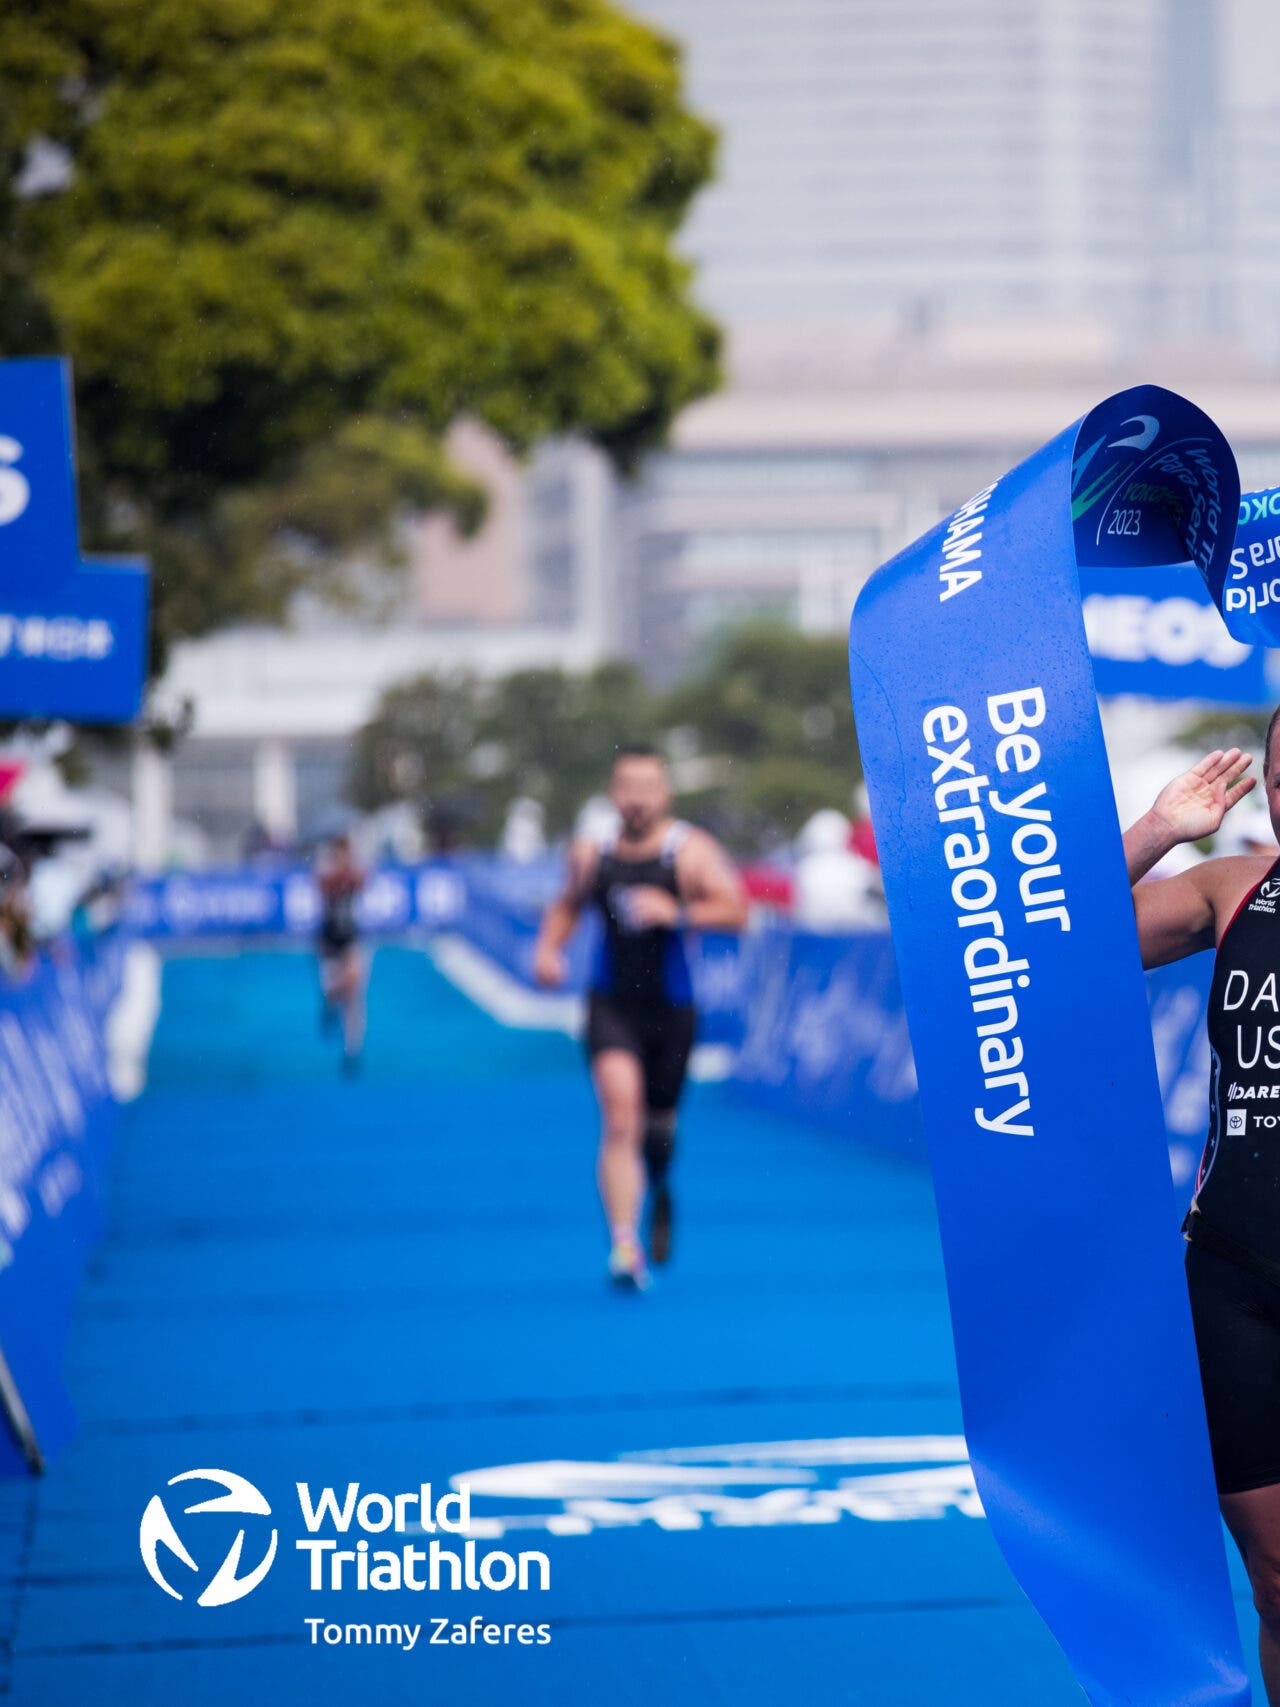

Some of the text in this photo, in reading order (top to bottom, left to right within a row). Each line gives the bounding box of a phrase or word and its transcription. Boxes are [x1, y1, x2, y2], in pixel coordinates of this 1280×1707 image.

[1149, 452, 1199, 488] Para
[1185, 448, 1222, 535] World
[938, 473, 1004, 603] OHAMA
[1106, 508, 1142, 537] 2023
[987, 686, 1071, 932] Be your
[922, 704, 1035, 1137] extraordinary
[1248, 903, 1276, 914] Triathlon
[1255, 898, 1276, 907] World
